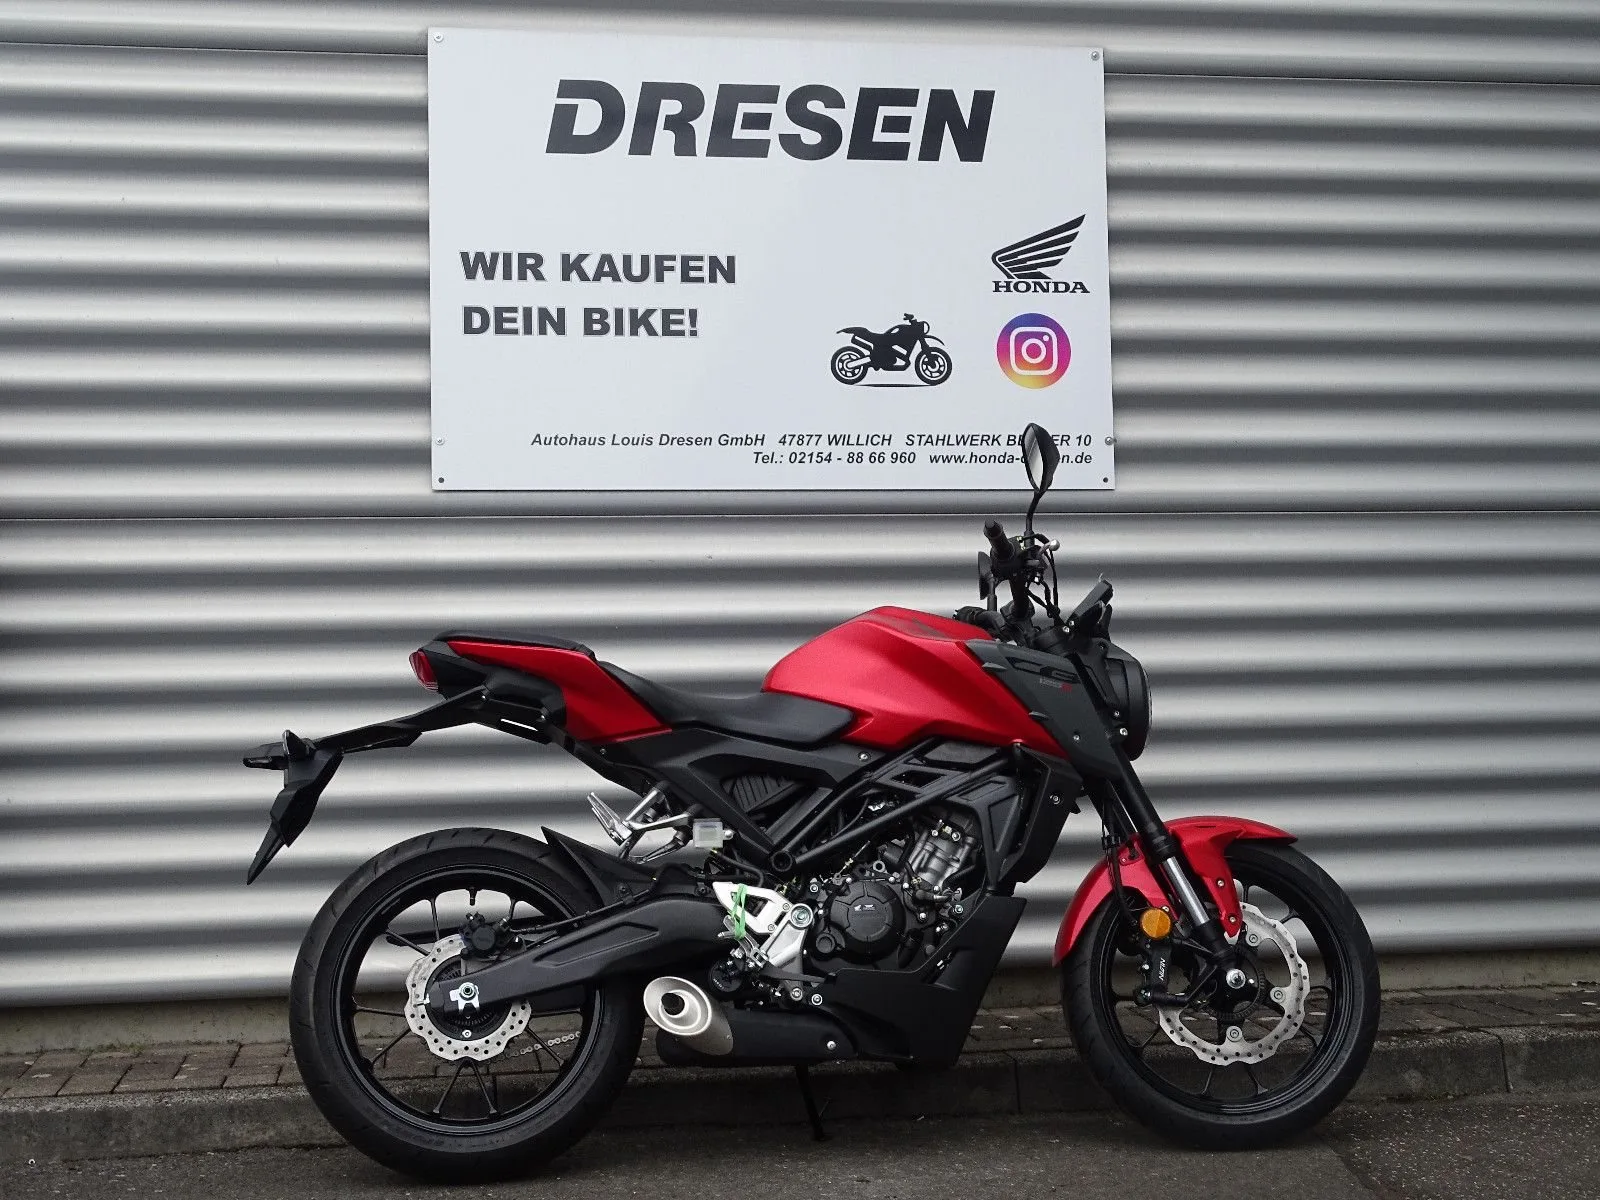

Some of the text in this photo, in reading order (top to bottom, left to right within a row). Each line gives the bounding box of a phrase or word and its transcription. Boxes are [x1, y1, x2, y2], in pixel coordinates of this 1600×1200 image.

[545, 79, 996, 163] DRESEN
[459, 252, 736, 284] WIR KAUFEN
[992, 280, 1091, 294] HONDA
[463, 306, 699, 337] DEIN BIKE!
[530, 434, 606, 447] Autohaus
[611, 434, 654, 447] Louis
[658, 434, 713, 447] Dresen
[718, 434, 766, 447] GmbH
[778, 434, 823, 447] 47877
[828, 434, 893, 447] WILLICH
[905, 434, 1002, 447] STAHLWERK
[1075, 434, 1092, 447] 10
[753, 451, 784, 464] Tel.:
[789, 451, 833, 464] 02154
[847, 451, 864, 464] 88
[869, 451, 886, 464] 66
[890, 451, 917, 464] 960
